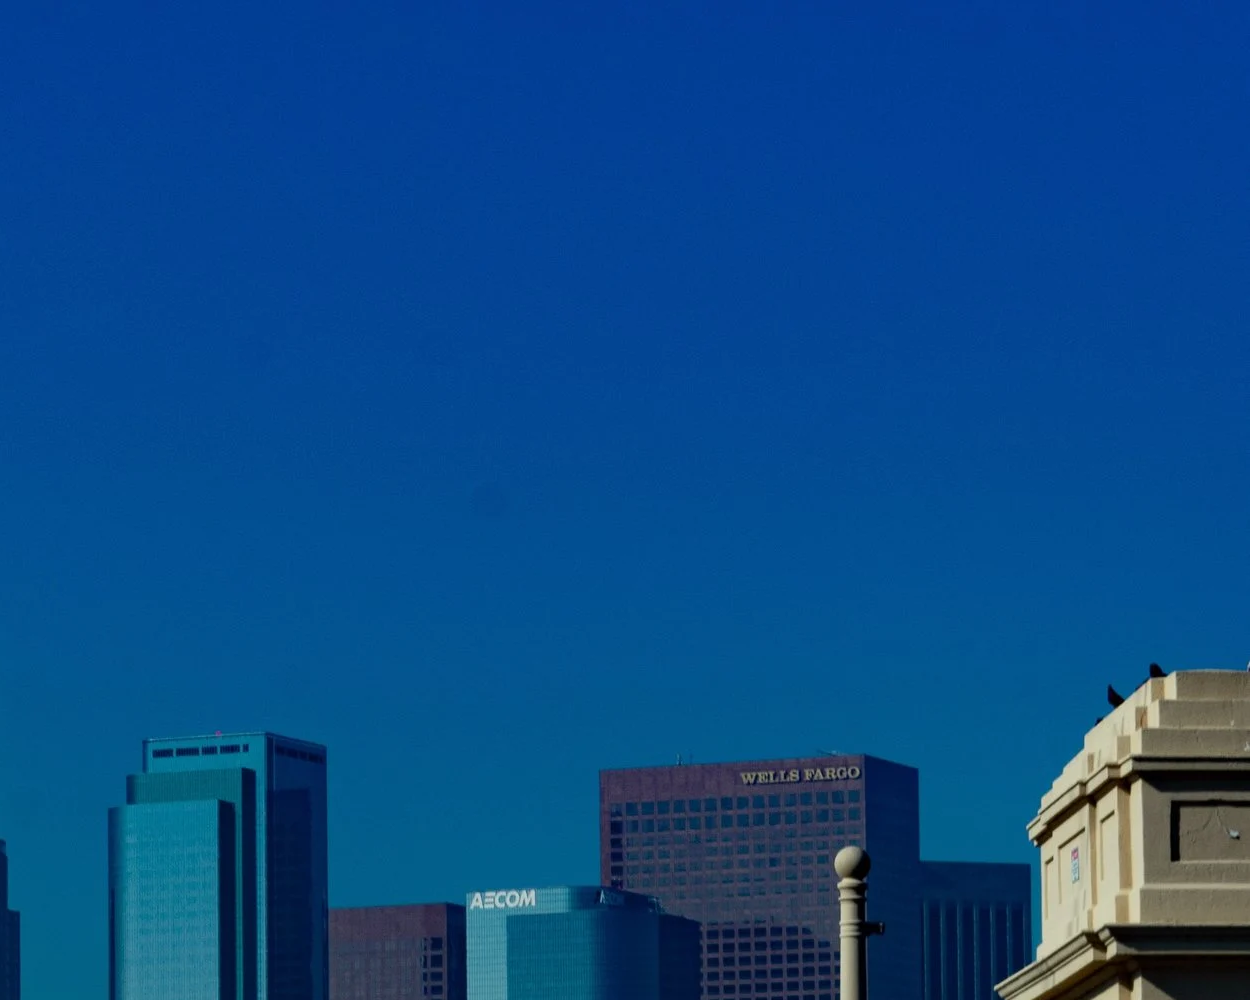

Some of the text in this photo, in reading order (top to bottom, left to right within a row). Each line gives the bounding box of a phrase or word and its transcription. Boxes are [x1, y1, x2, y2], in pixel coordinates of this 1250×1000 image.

[740, 766, 861, 785] WELLS FARGO
[470, 889, 536, 909] AECOM
